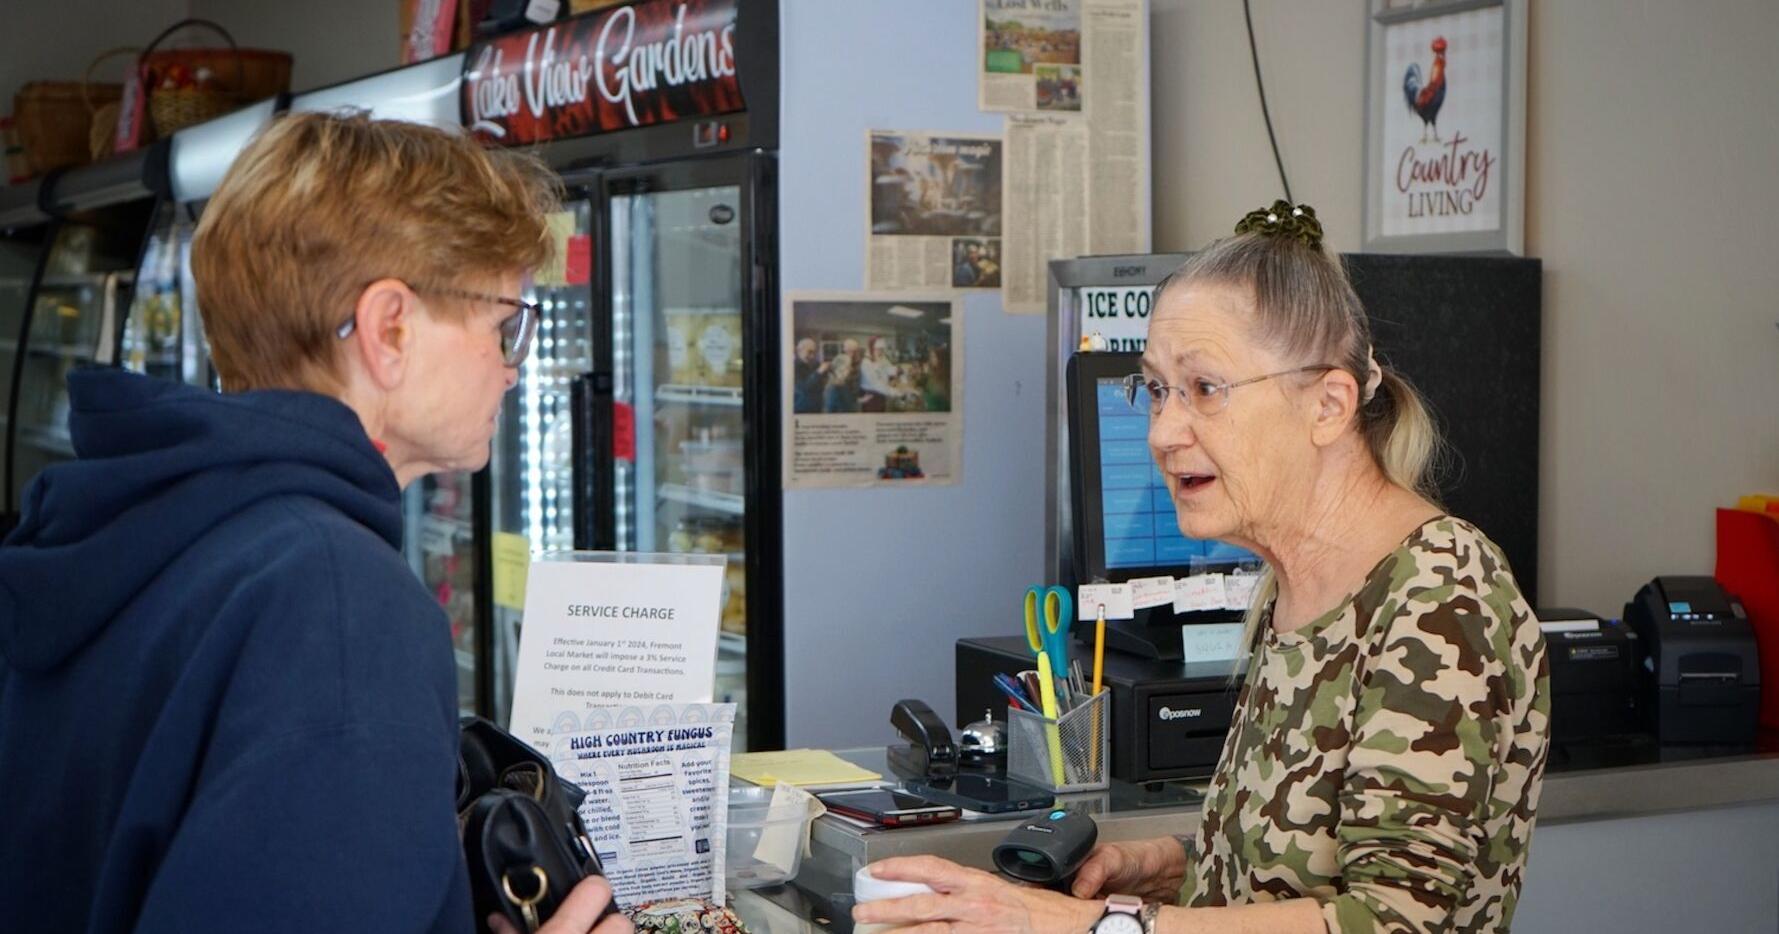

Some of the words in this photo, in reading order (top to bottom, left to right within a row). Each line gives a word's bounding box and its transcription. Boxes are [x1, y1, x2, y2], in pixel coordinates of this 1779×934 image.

[465, 44, 519, 138] Lake
[525, 27, 594, 118] View
[596, 3, 736, 126] Gardens
[1396, 130, 1495, 201] Country
[1408, 189, 1473, 218] LIVING
[1088, 292, 1118, 317] ICE
[1124, 292, 1150, 317] CO
[567, 605, 618, 618] SERVICE
[622, 606, 675, 620] CHARGE
[553, 638, 584, 646] Effective
[586, 639, 615, 648] January
[628, 641, 648, 649] 2024,
[650, 641, 682, 650] Fremont
[546, 650, 564, 658] Local
[567, 650, 593, 659] Market
[595, 651, 608, 659] will
[611, 652, 637, 662] impose
[544, 663, 569, 671] Charge
[582, 663, 591, 671] all
[593, 664, 615, 672] Credit
[617, 665, 634, 673] Card
[637, 666, 684, 675] Transactions.
[567, 688, 584, 697] does
[586, 689, 599, 697] not
[601, 689, 622, 699] apply
[633, 691, 654, 699] Debit
[655, 691, 674, 700] Card
[533, 740, 550, 748] may
[570, 735, 602, 750] HIGH
[606, 730, 664, 746] COUNTRY
[667, 726, 713, 741] FUNGUS
[577, 752, 602, 760] WHERE
[603, 748, 624, 758] EVERY
[627, 746, 665, 755] MUSHROOM
[676, 742, 706, 751] MAGICAL
[618, 760, 648, 770] Nutrition
